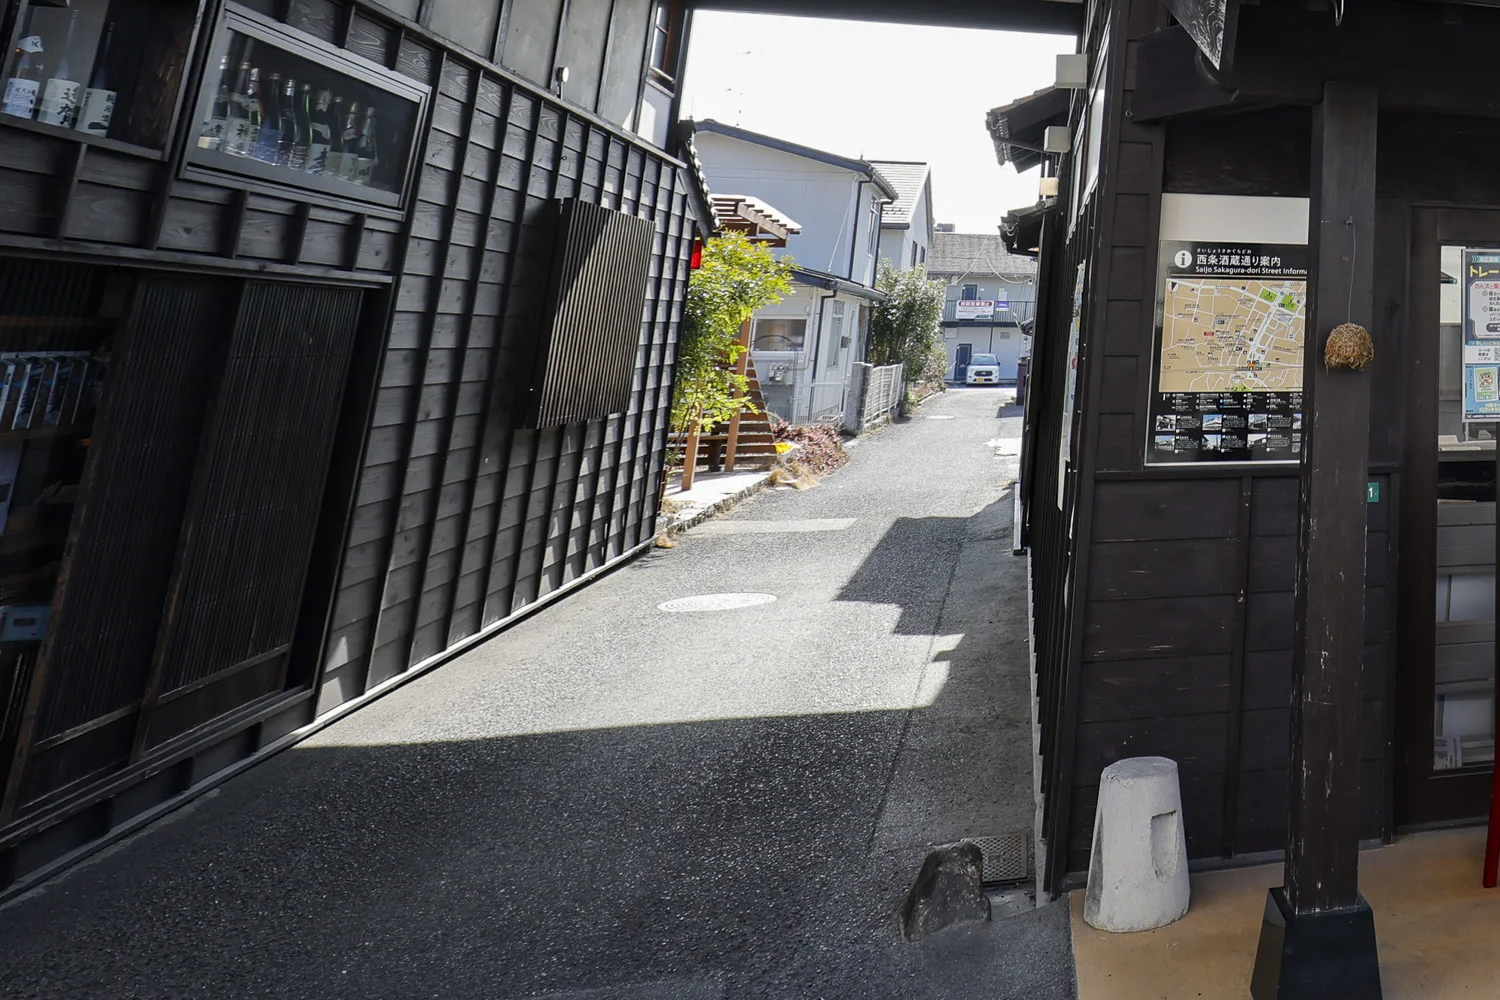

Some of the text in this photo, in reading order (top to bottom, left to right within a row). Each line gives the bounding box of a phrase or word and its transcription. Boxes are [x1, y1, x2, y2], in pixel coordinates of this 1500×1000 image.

[1196, 254, 1281, 267] 西条酒蔵通り案内
[1195, 266, 1213, 274] Saijo
[1213, 266, 1261, 275] Sakagura-dori
[1261, 267, 1282, 275] Street
